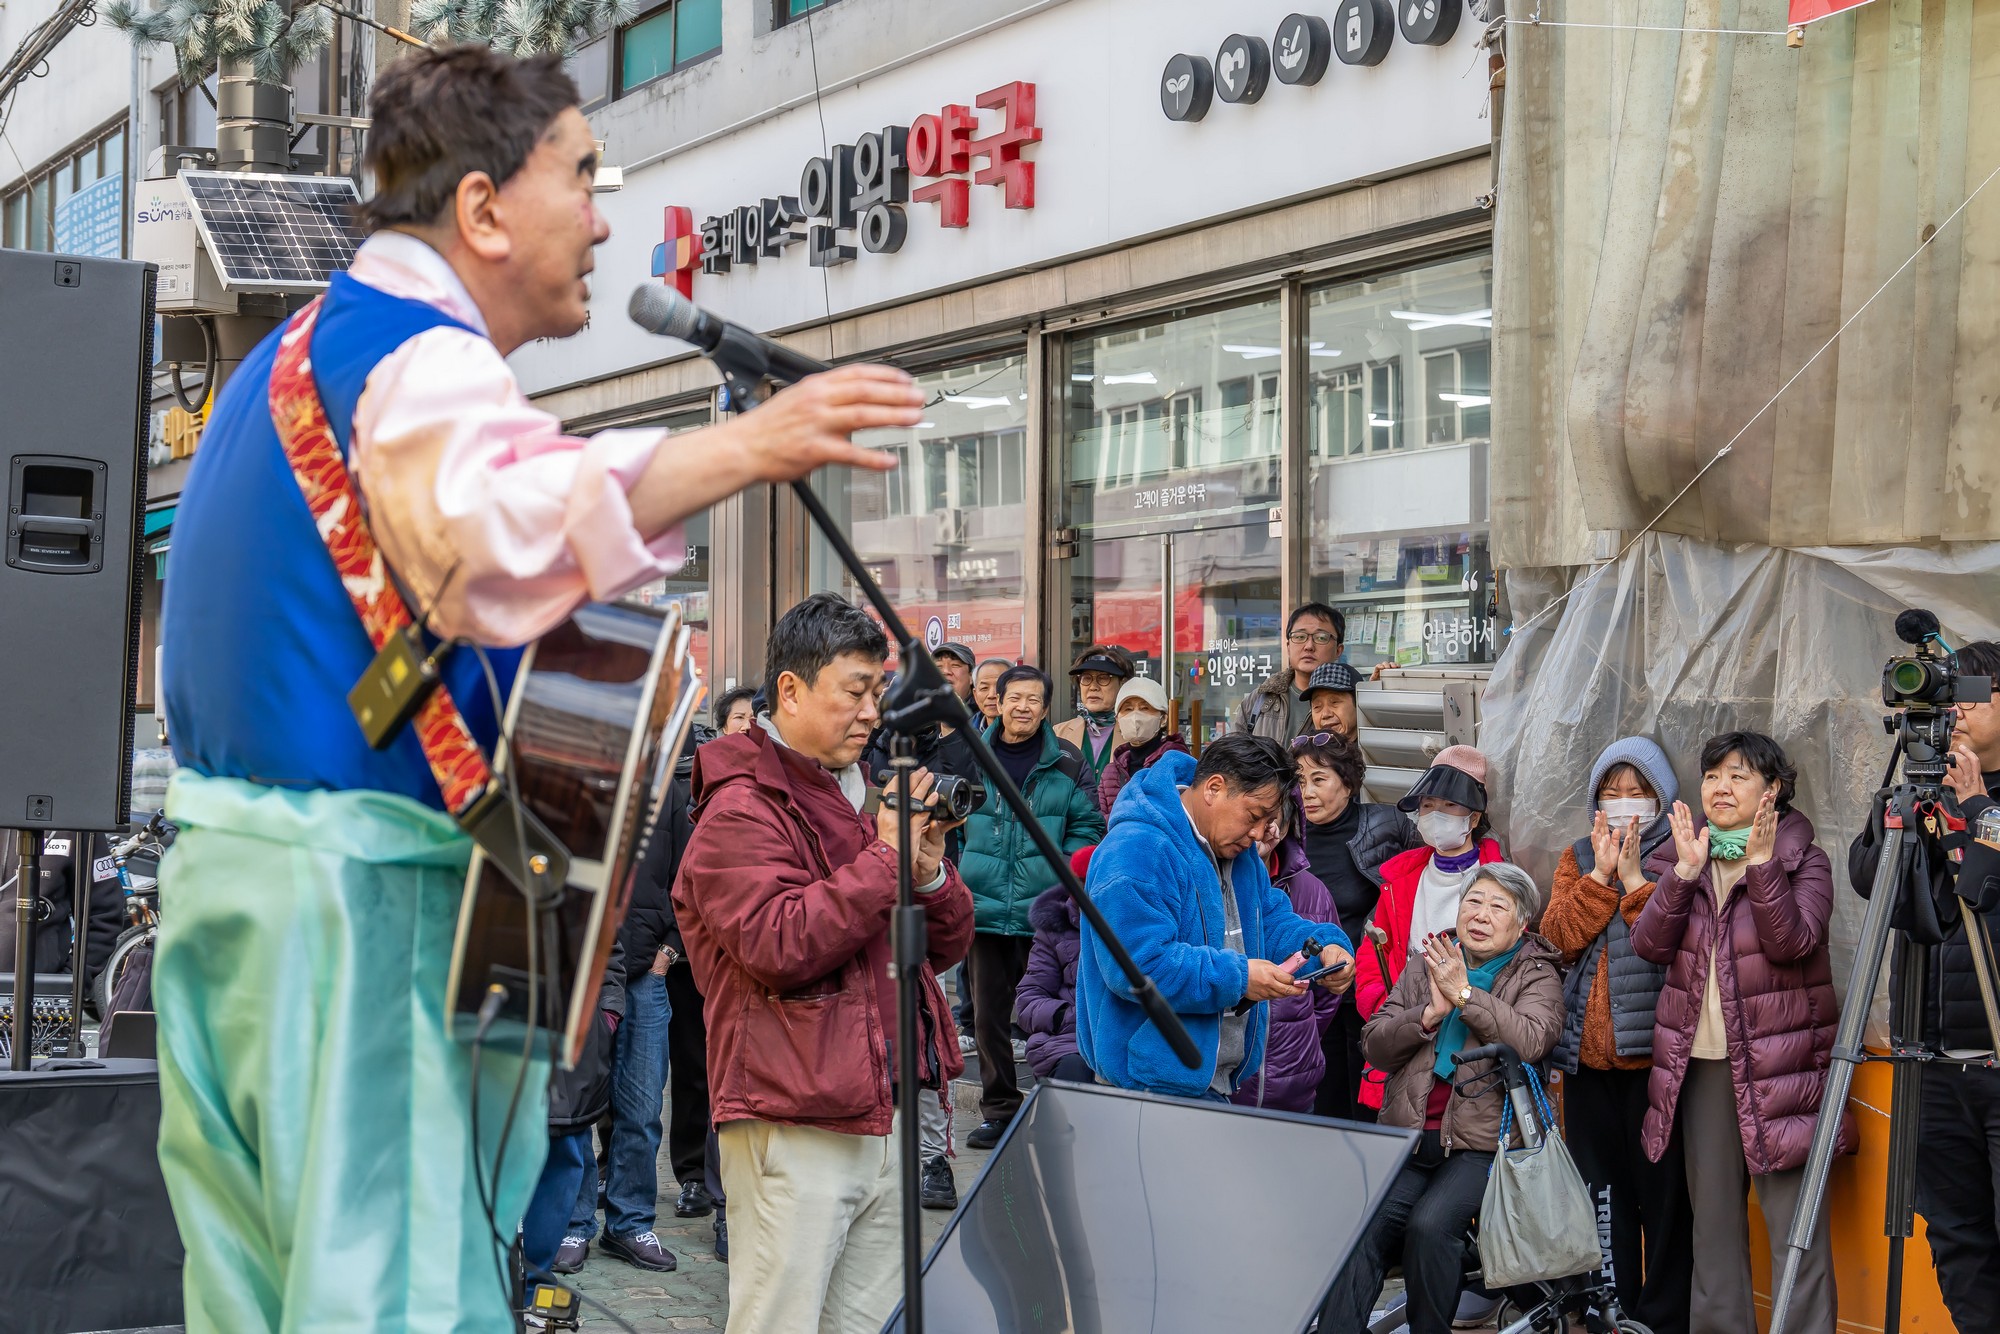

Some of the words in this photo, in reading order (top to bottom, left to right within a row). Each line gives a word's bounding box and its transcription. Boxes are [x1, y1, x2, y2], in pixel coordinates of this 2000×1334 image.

[700, 194, 808, 275] 휴베이스
[1134, 489, 1159, 509] 고객이
[1160, 485, 1187, 507] 즐거운
[1187, 483, 1206, 503] 약국
[1208, 638, 1238, 654] 휴베이스
[1207, 654, 1273, 686] 인왕약국
